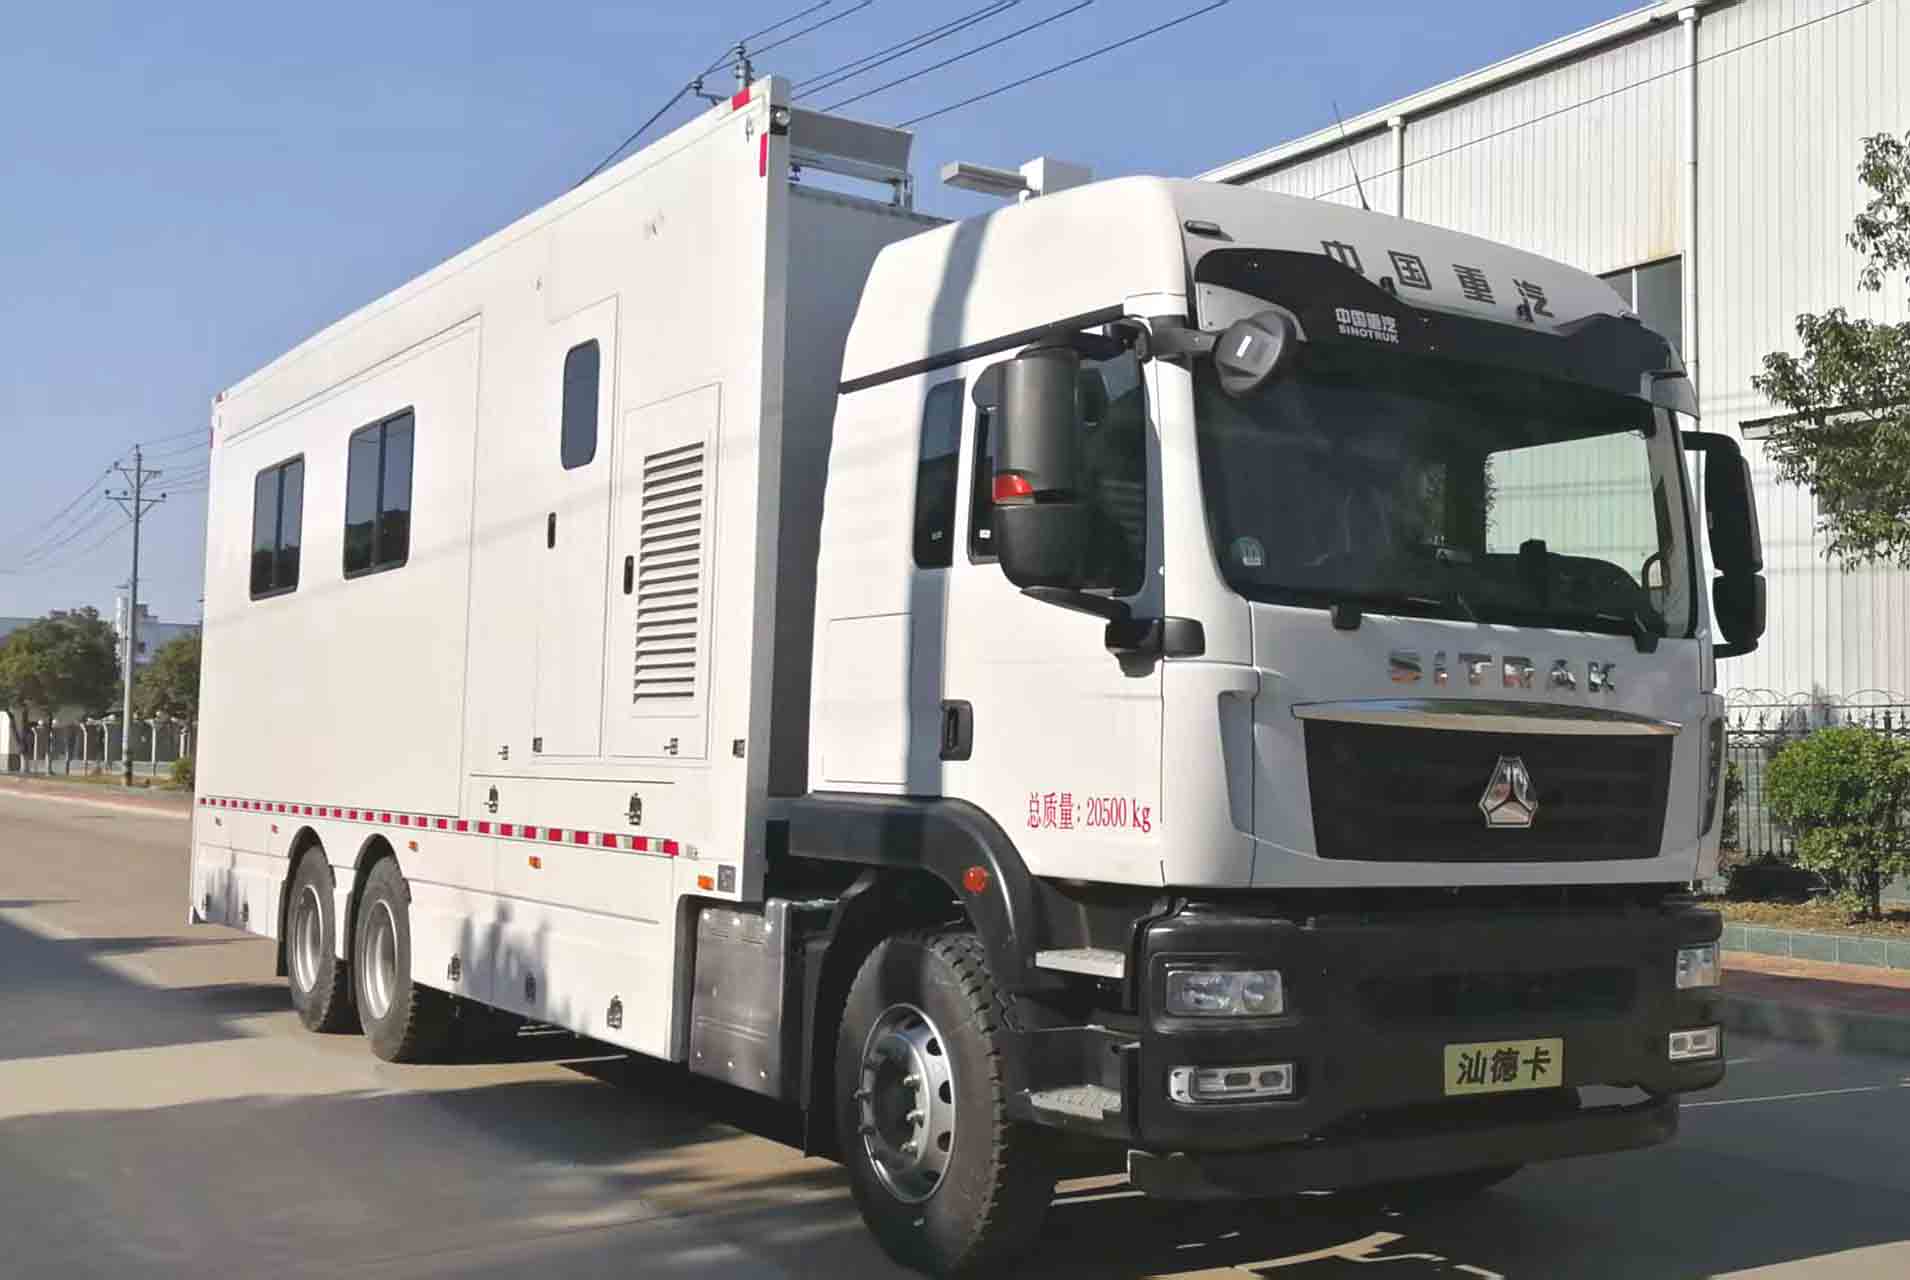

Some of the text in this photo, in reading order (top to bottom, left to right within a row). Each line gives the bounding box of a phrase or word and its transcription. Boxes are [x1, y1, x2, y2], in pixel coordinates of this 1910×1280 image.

[1337, 324, 1400, 344] SINOTRUK
[1388, 650, 1617, 693] SITRAK
[1132, 799, 1152, 833] kg
[1456, 1046, 1552, 1085] 汕德卡
